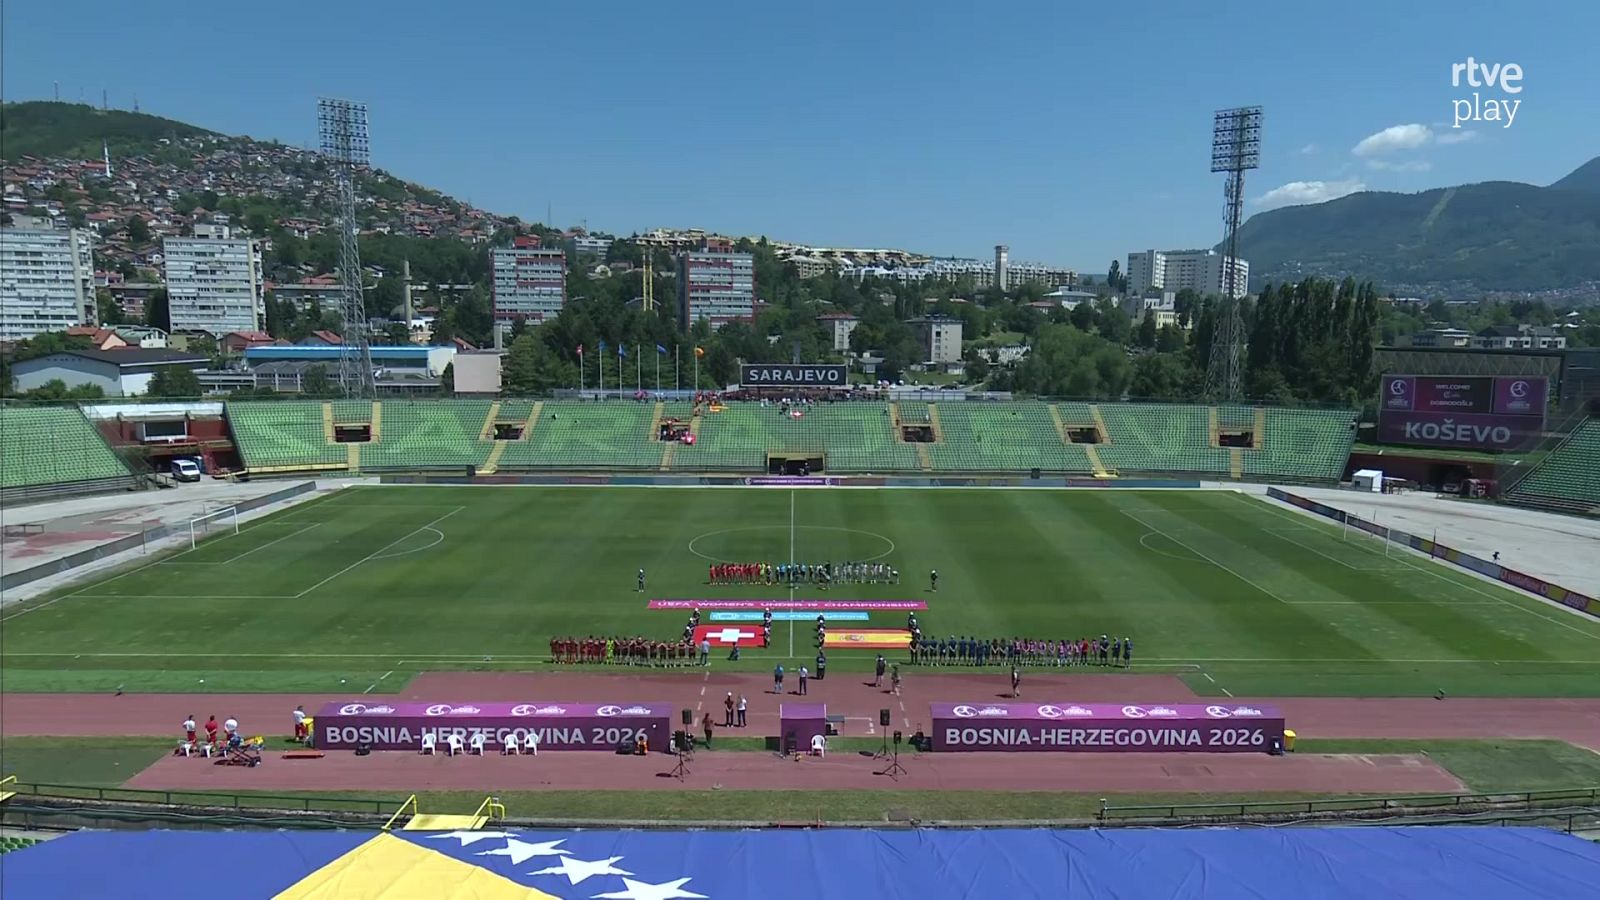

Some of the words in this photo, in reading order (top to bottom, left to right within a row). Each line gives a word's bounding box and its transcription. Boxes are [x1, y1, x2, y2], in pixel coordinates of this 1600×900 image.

[749, 369, 839, 381] SARAJEVO
[1404, 418, 1511, 443] KOŠEVO
[326, 726, 586, 744] BOSNIA-HERZEGOVINA
[592, 727, 648, 745] 2026
[945, 728, 1202, 747] BOSNIA-HERZEGOVINA
[1208, 728, 1265, 746] 2026
